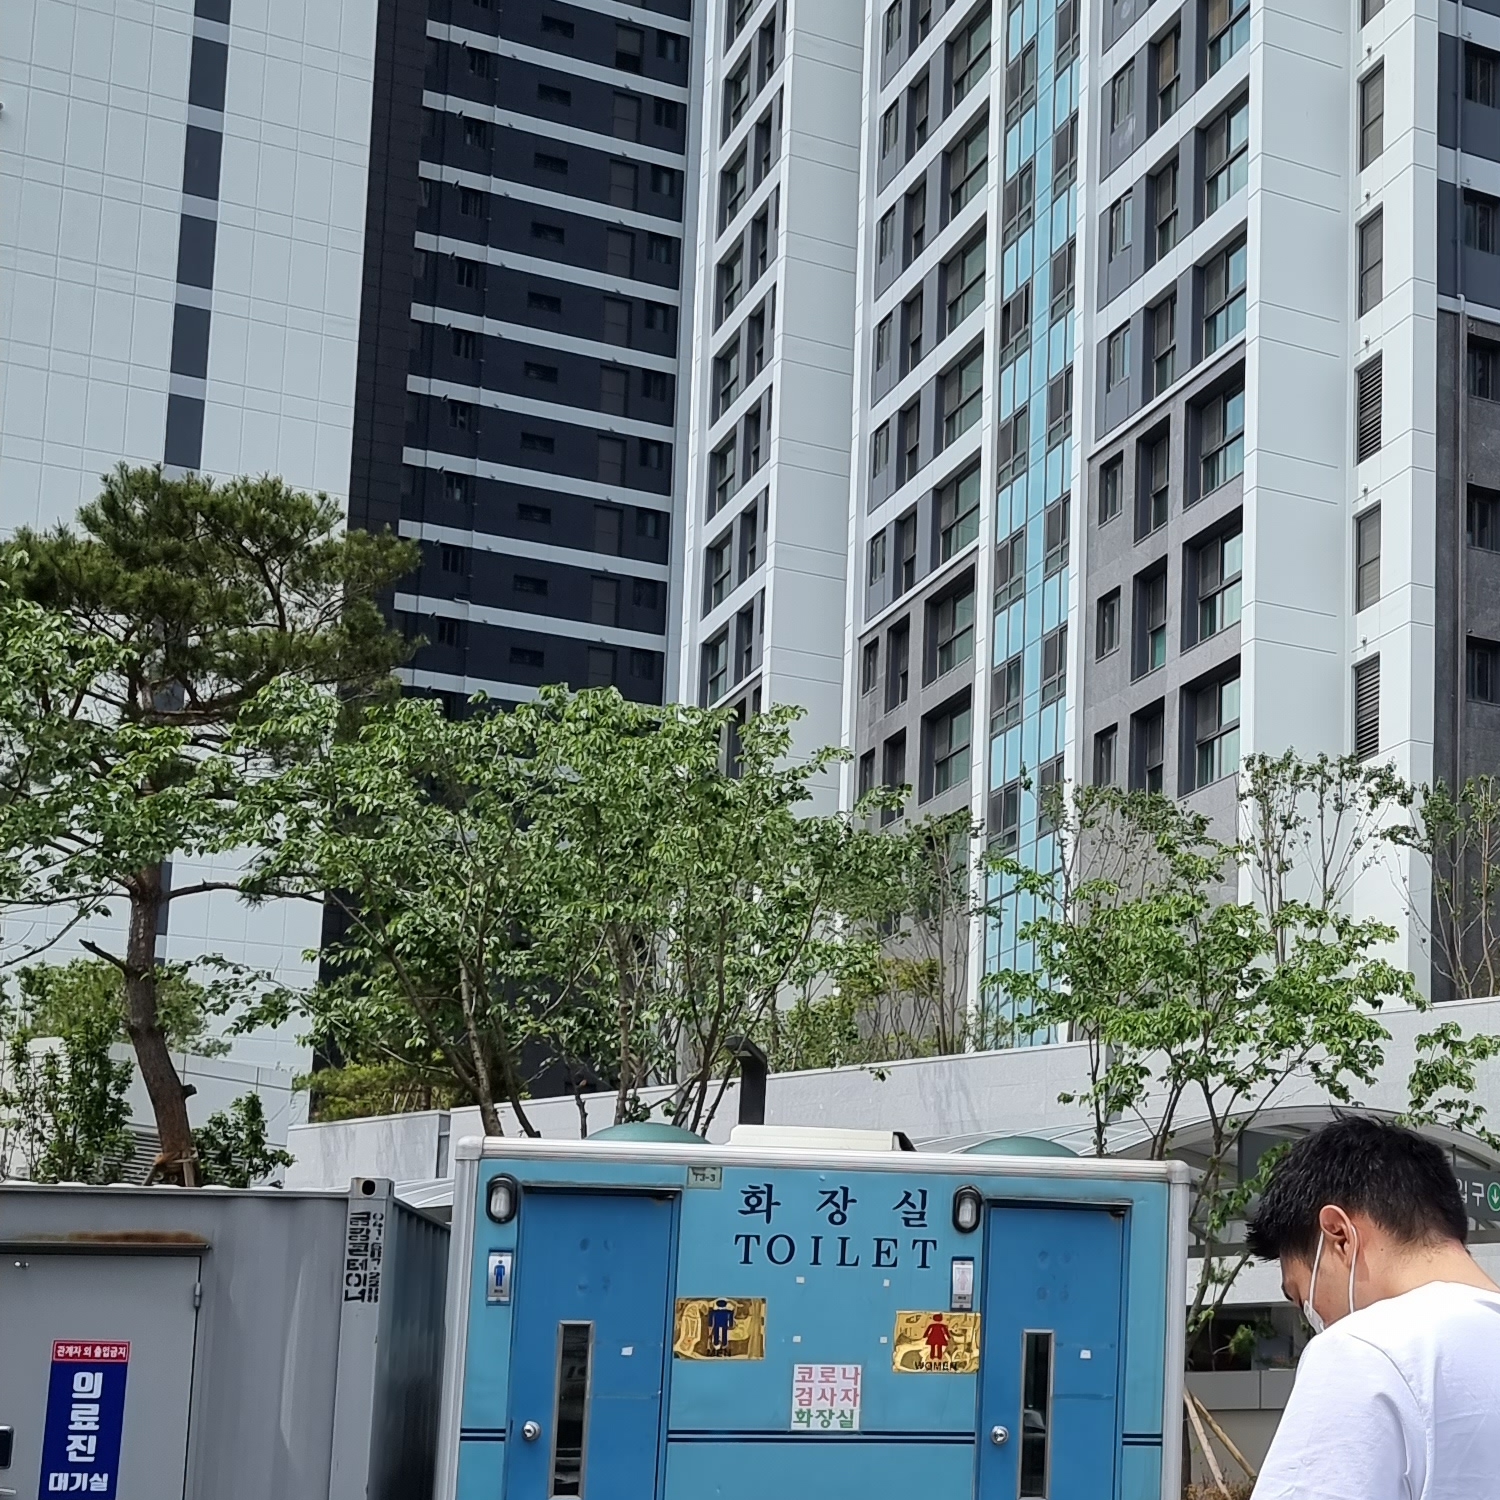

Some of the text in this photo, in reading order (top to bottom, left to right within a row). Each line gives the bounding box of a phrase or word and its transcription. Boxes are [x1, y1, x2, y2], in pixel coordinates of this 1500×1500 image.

[737, 1183, 928, 1228] 화장실
[734, 1234, 938, 1269] TOILET
[57, 1345, 126, 1358] 관계자 외 출입금지
[795, 1366, 860, 1386] 코로나
[914, 1361, 958, 1372] WOMEN
[794, 1387, 860, 1407] 검사자
[66, 1371, 103, 1462] 의료진
[793, 1409, 855, 1429] 화장실
[48, 1472, 109, 1492] 대기실
